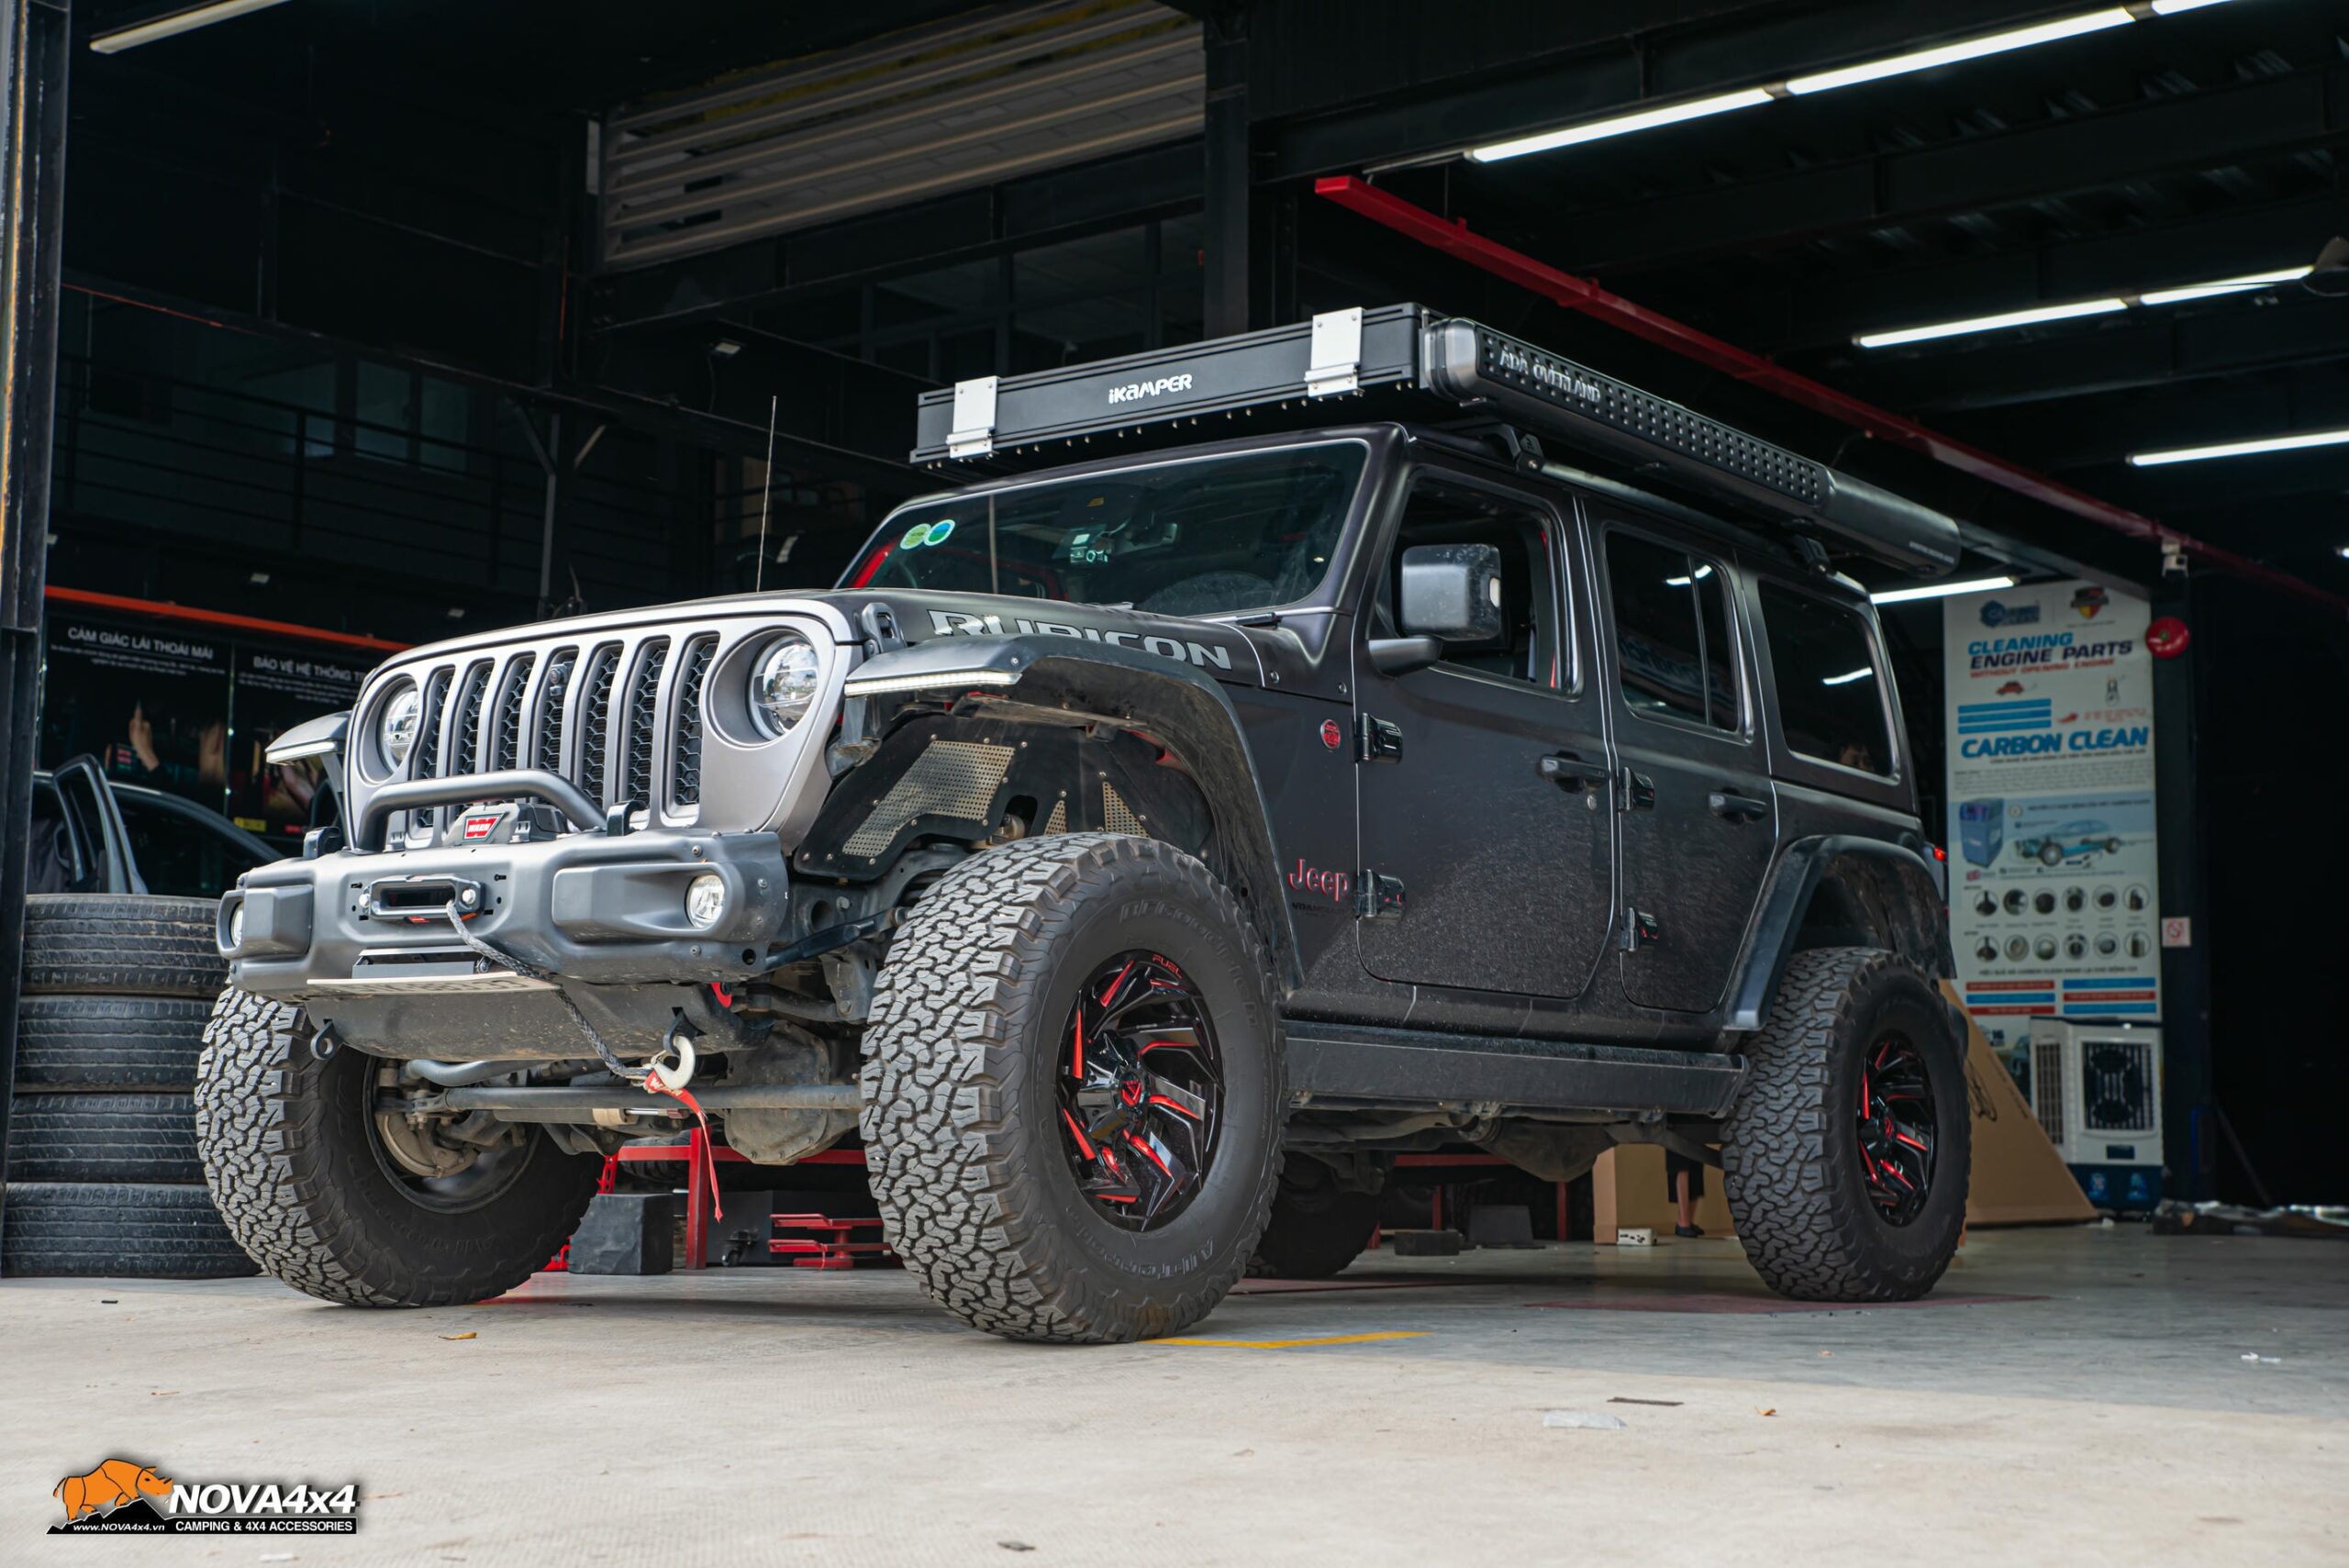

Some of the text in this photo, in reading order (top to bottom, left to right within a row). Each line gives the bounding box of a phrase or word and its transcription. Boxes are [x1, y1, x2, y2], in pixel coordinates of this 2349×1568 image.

[99, 630, 129, 648] GIÁC
[132, 635, 151, 651] LÁI
[1967, 631, 2074, 656] CLEANING
[1970, 639, 2133, 670] ENGINE PARTS
[1960, 731, 2063, 760] CARBON
[2067, 726, 2149, 752] CLEAN
[1286, 857, 1352, 904] Jeep
[1152, 953, 1184, 980] FUEL
